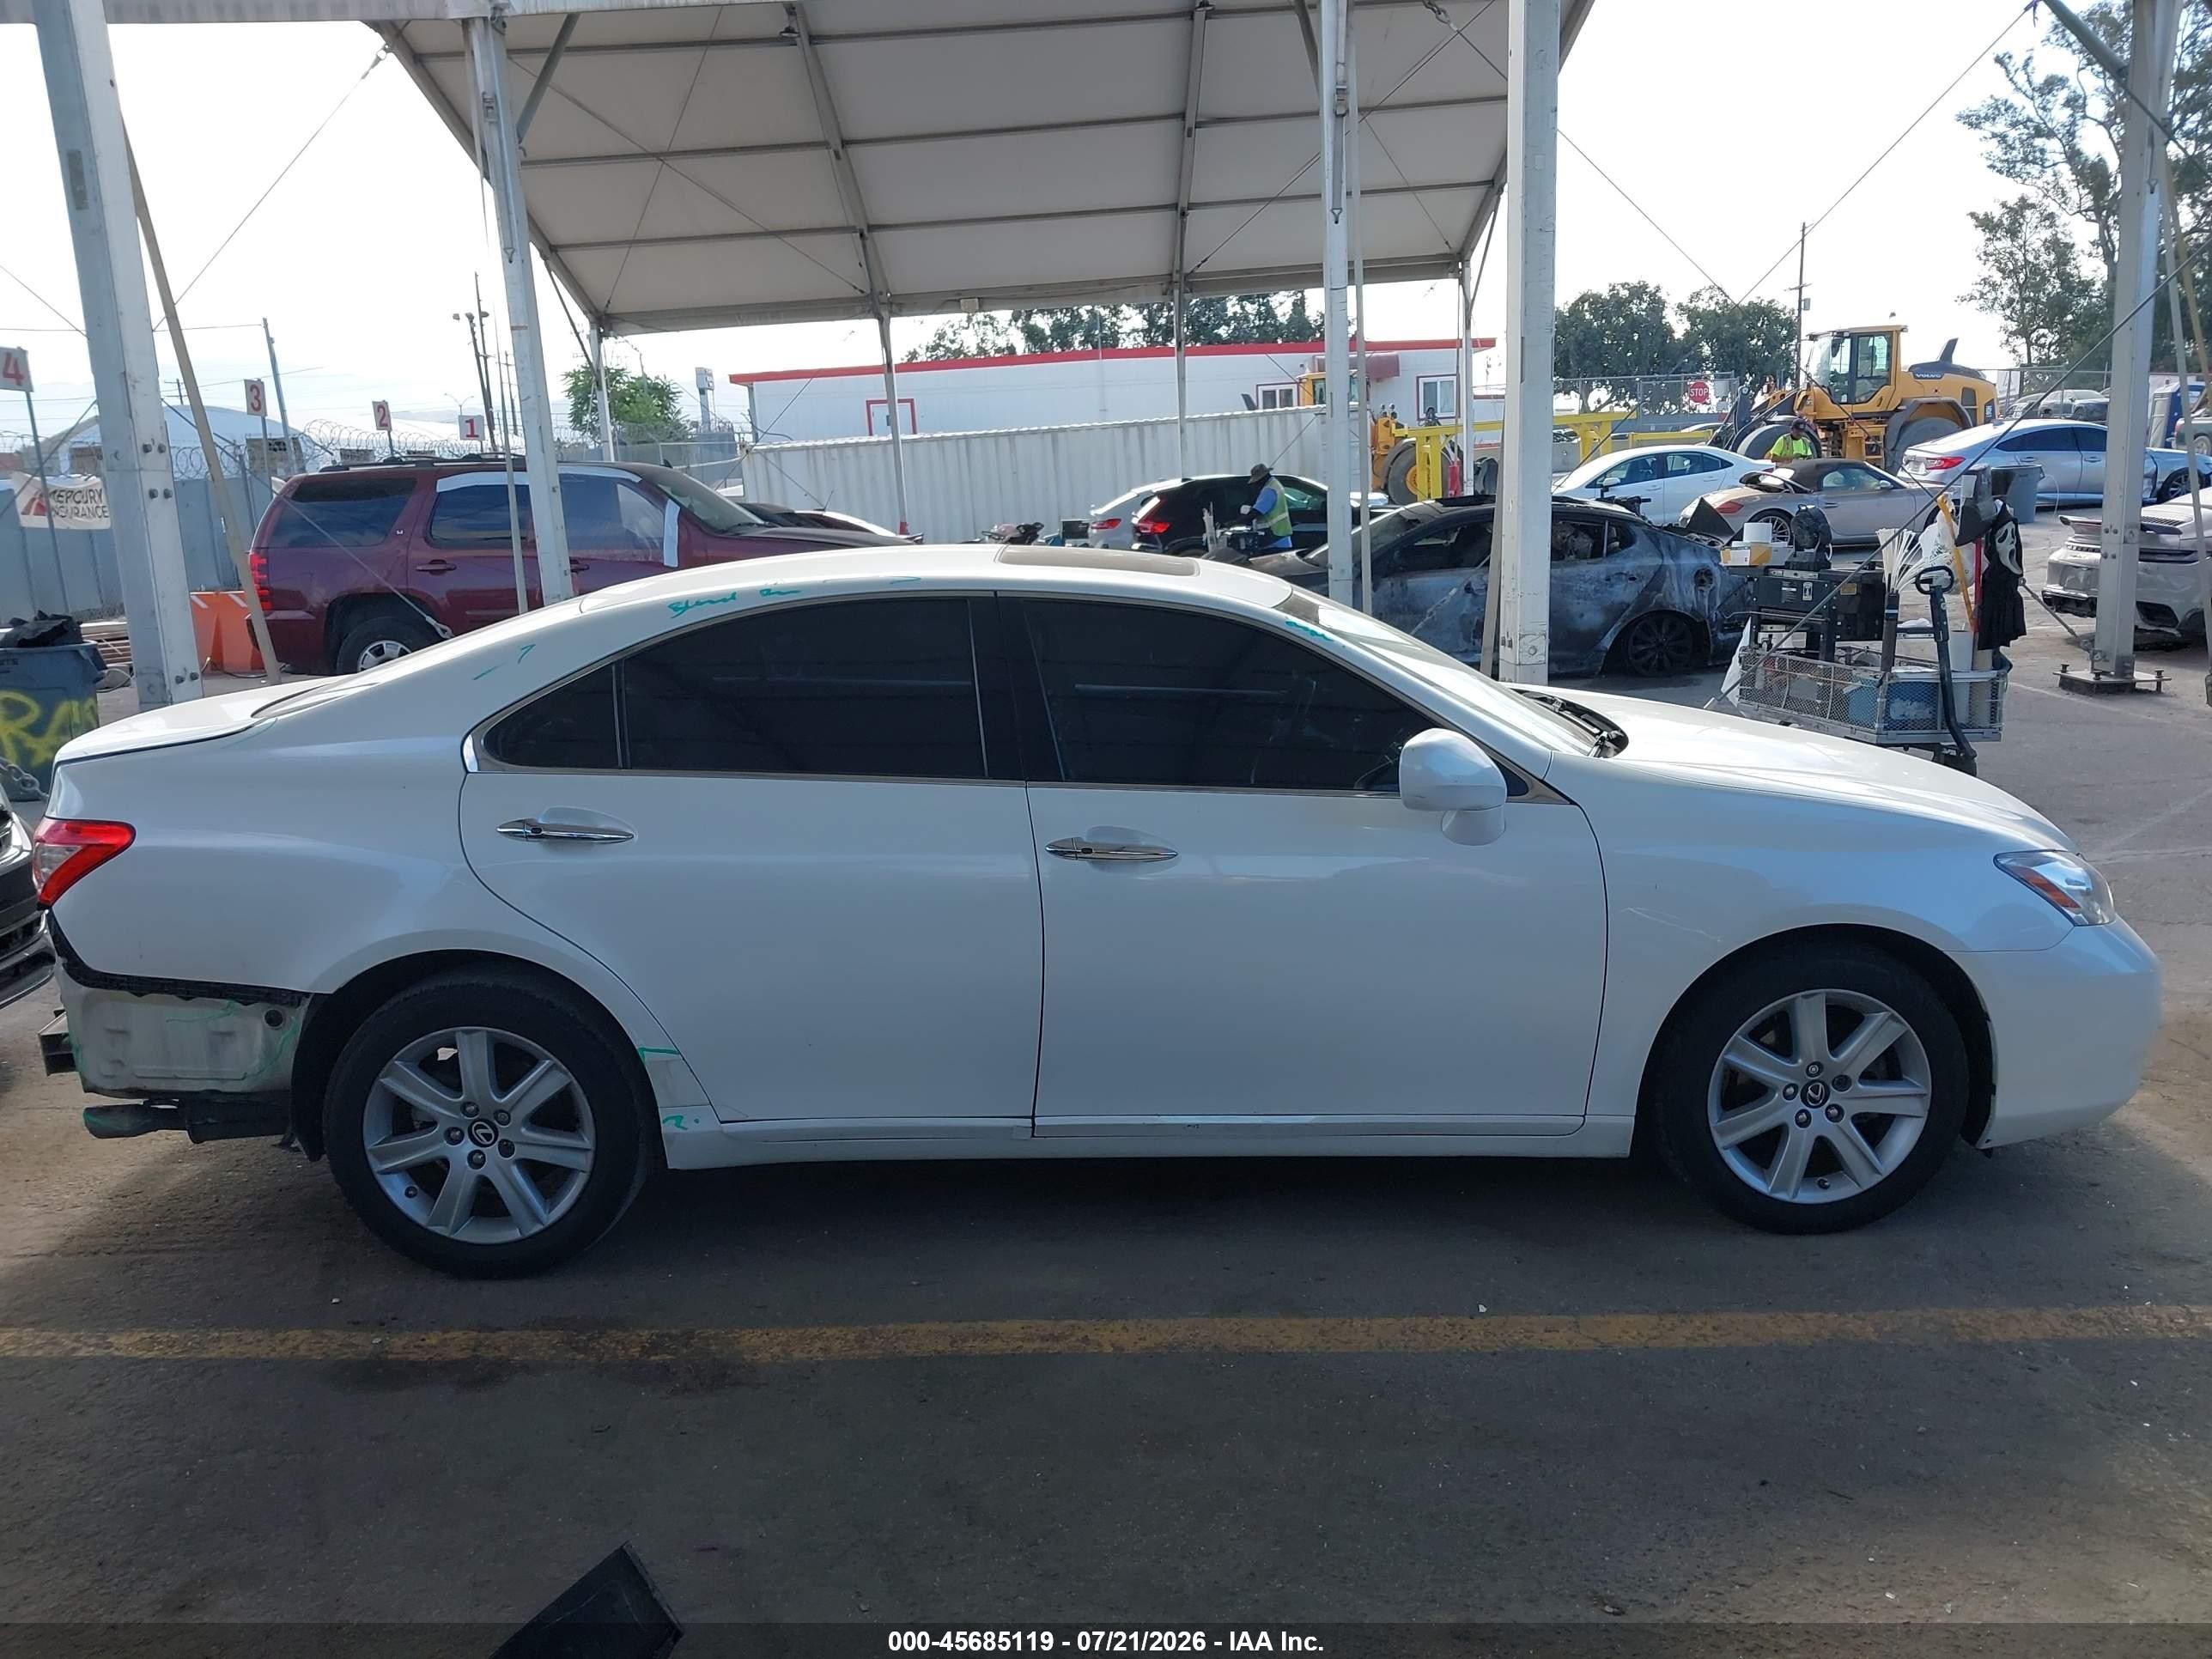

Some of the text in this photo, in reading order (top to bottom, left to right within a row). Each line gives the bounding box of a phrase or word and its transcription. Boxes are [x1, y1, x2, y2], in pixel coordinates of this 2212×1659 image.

[3, 352, 24, 386] 4
[250, 384, 261, 412] 3
[1690, 388, 1709, 397] STOP
[378, 404, 388, 427] 2
[465, 418, 479, 438] 1
[52, 506, 109, 519] NSURANCE
